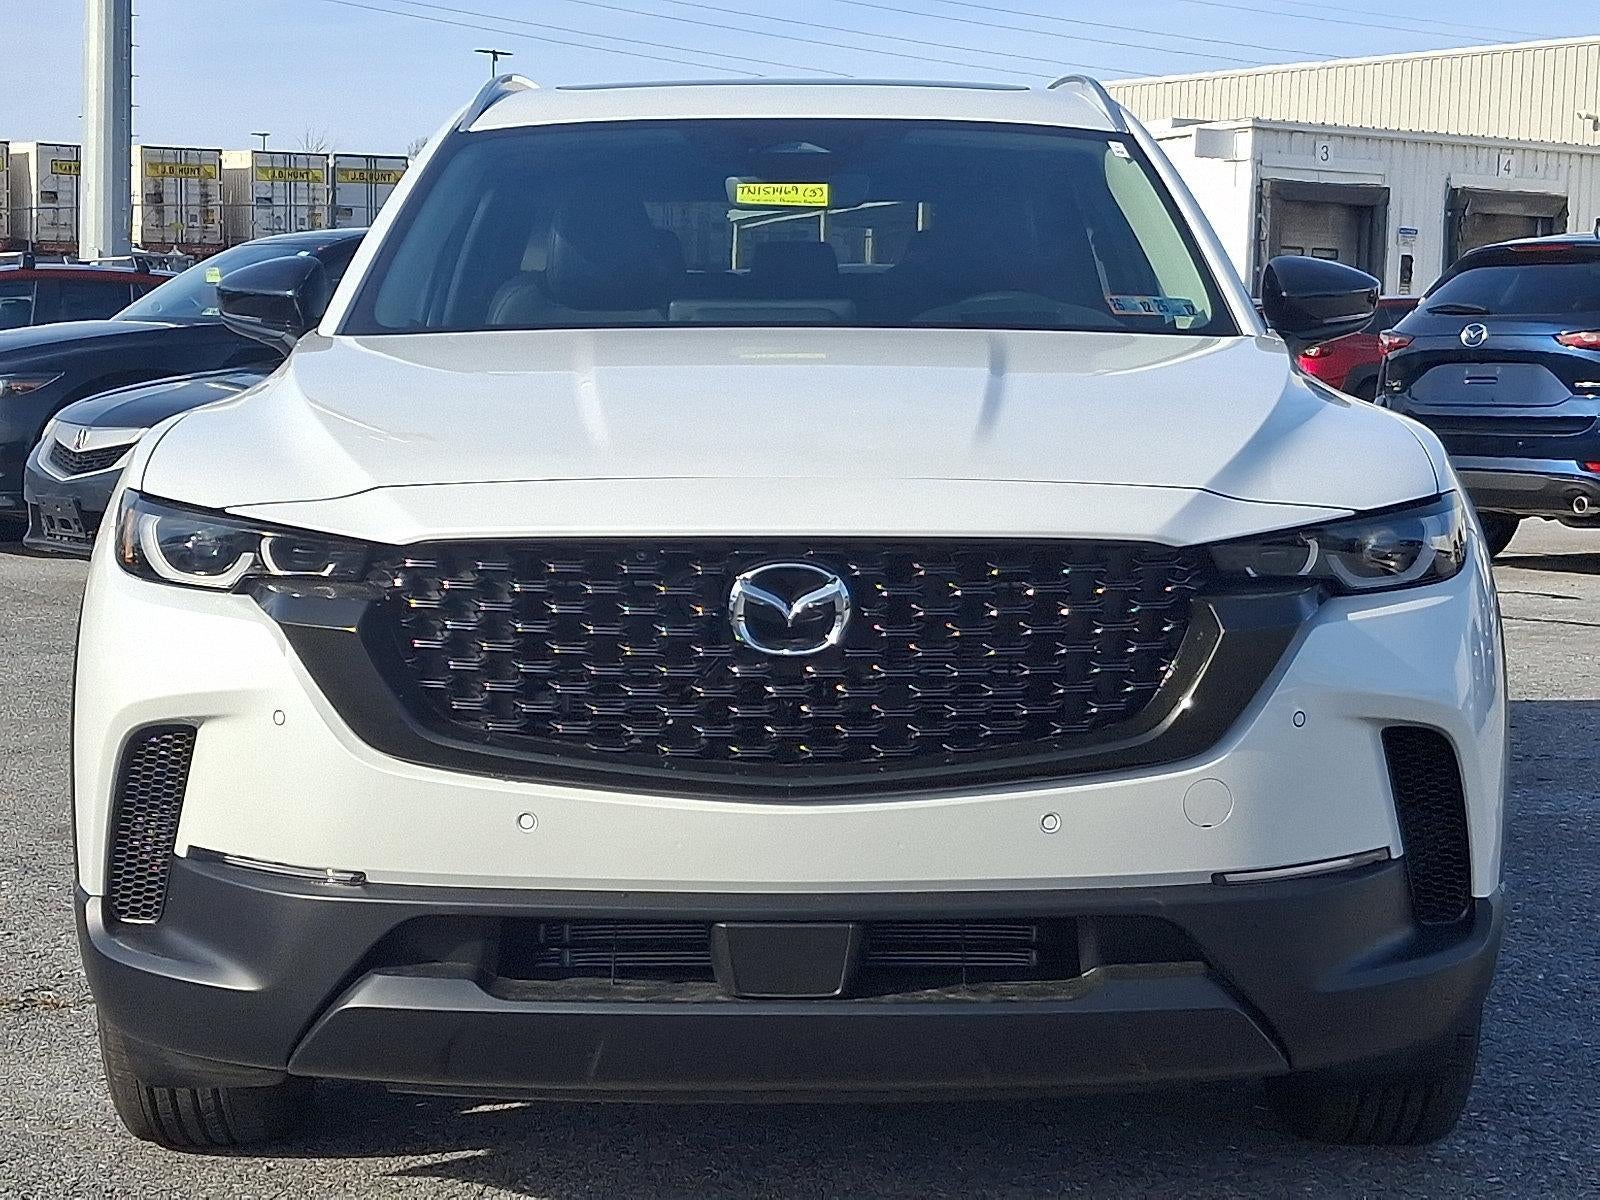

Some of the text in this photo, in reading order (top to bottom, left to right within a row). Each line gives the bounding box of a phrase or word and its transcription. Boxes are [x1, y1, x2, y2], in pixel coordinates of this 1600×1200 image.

[1319, 145, 1330, 162] 3
[178, 167, 200, 175] HUNT
[1503, 159, 1513, 174] 4
[288, 172, 310, 180] HUNT
[369, 172, 392, 182] HUNT
